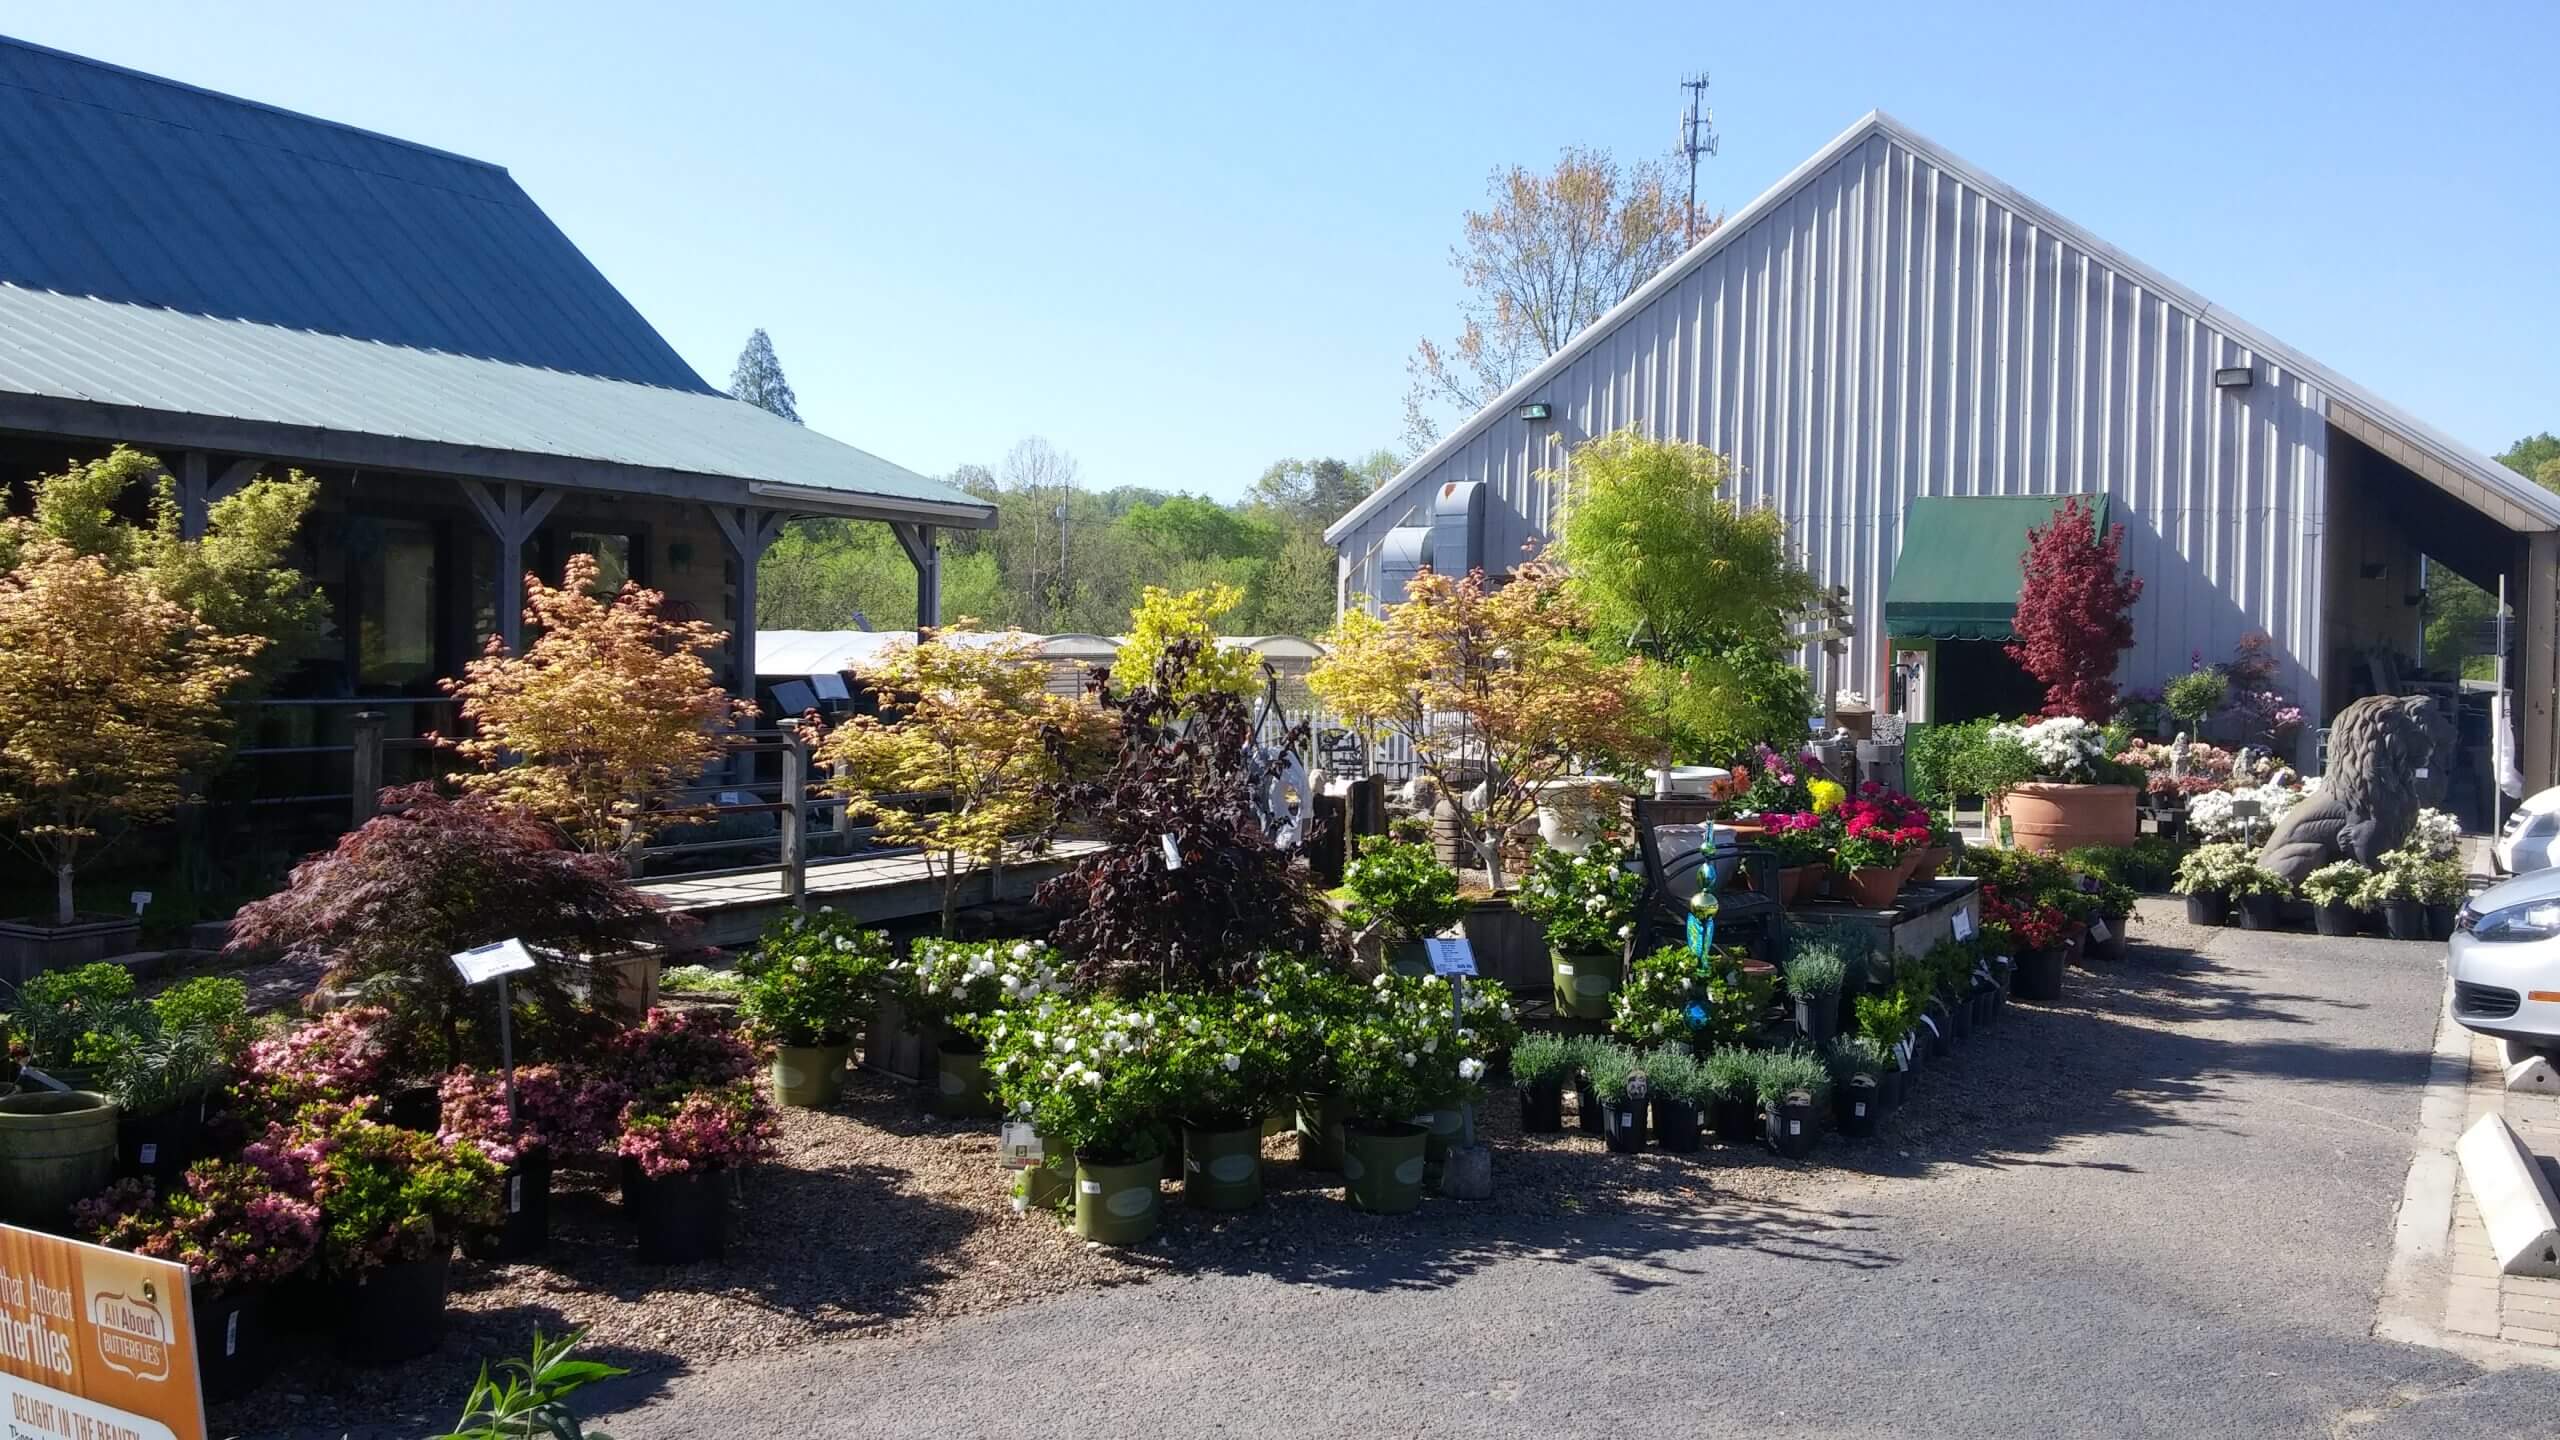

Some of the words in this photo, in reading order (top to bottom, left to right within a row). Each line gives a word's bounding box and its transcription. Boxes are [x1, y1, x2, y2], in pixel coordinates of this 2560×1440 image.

[30, 1271, 75, 1322] Attract
[104, 1302, 120, 1328] All
[121, 1306, 157, 1337] About
[0, 1307, 73, 1376] tterflies
[103, 1332, 161, 1367] BUTTERFLIES
[12, 1392, 55, 1432] DELIGHT
[58, 1408, 71, 1438] IN
[72, 1412, 94, 1440] THE
[97, 1420, 140, 1440] BEA
